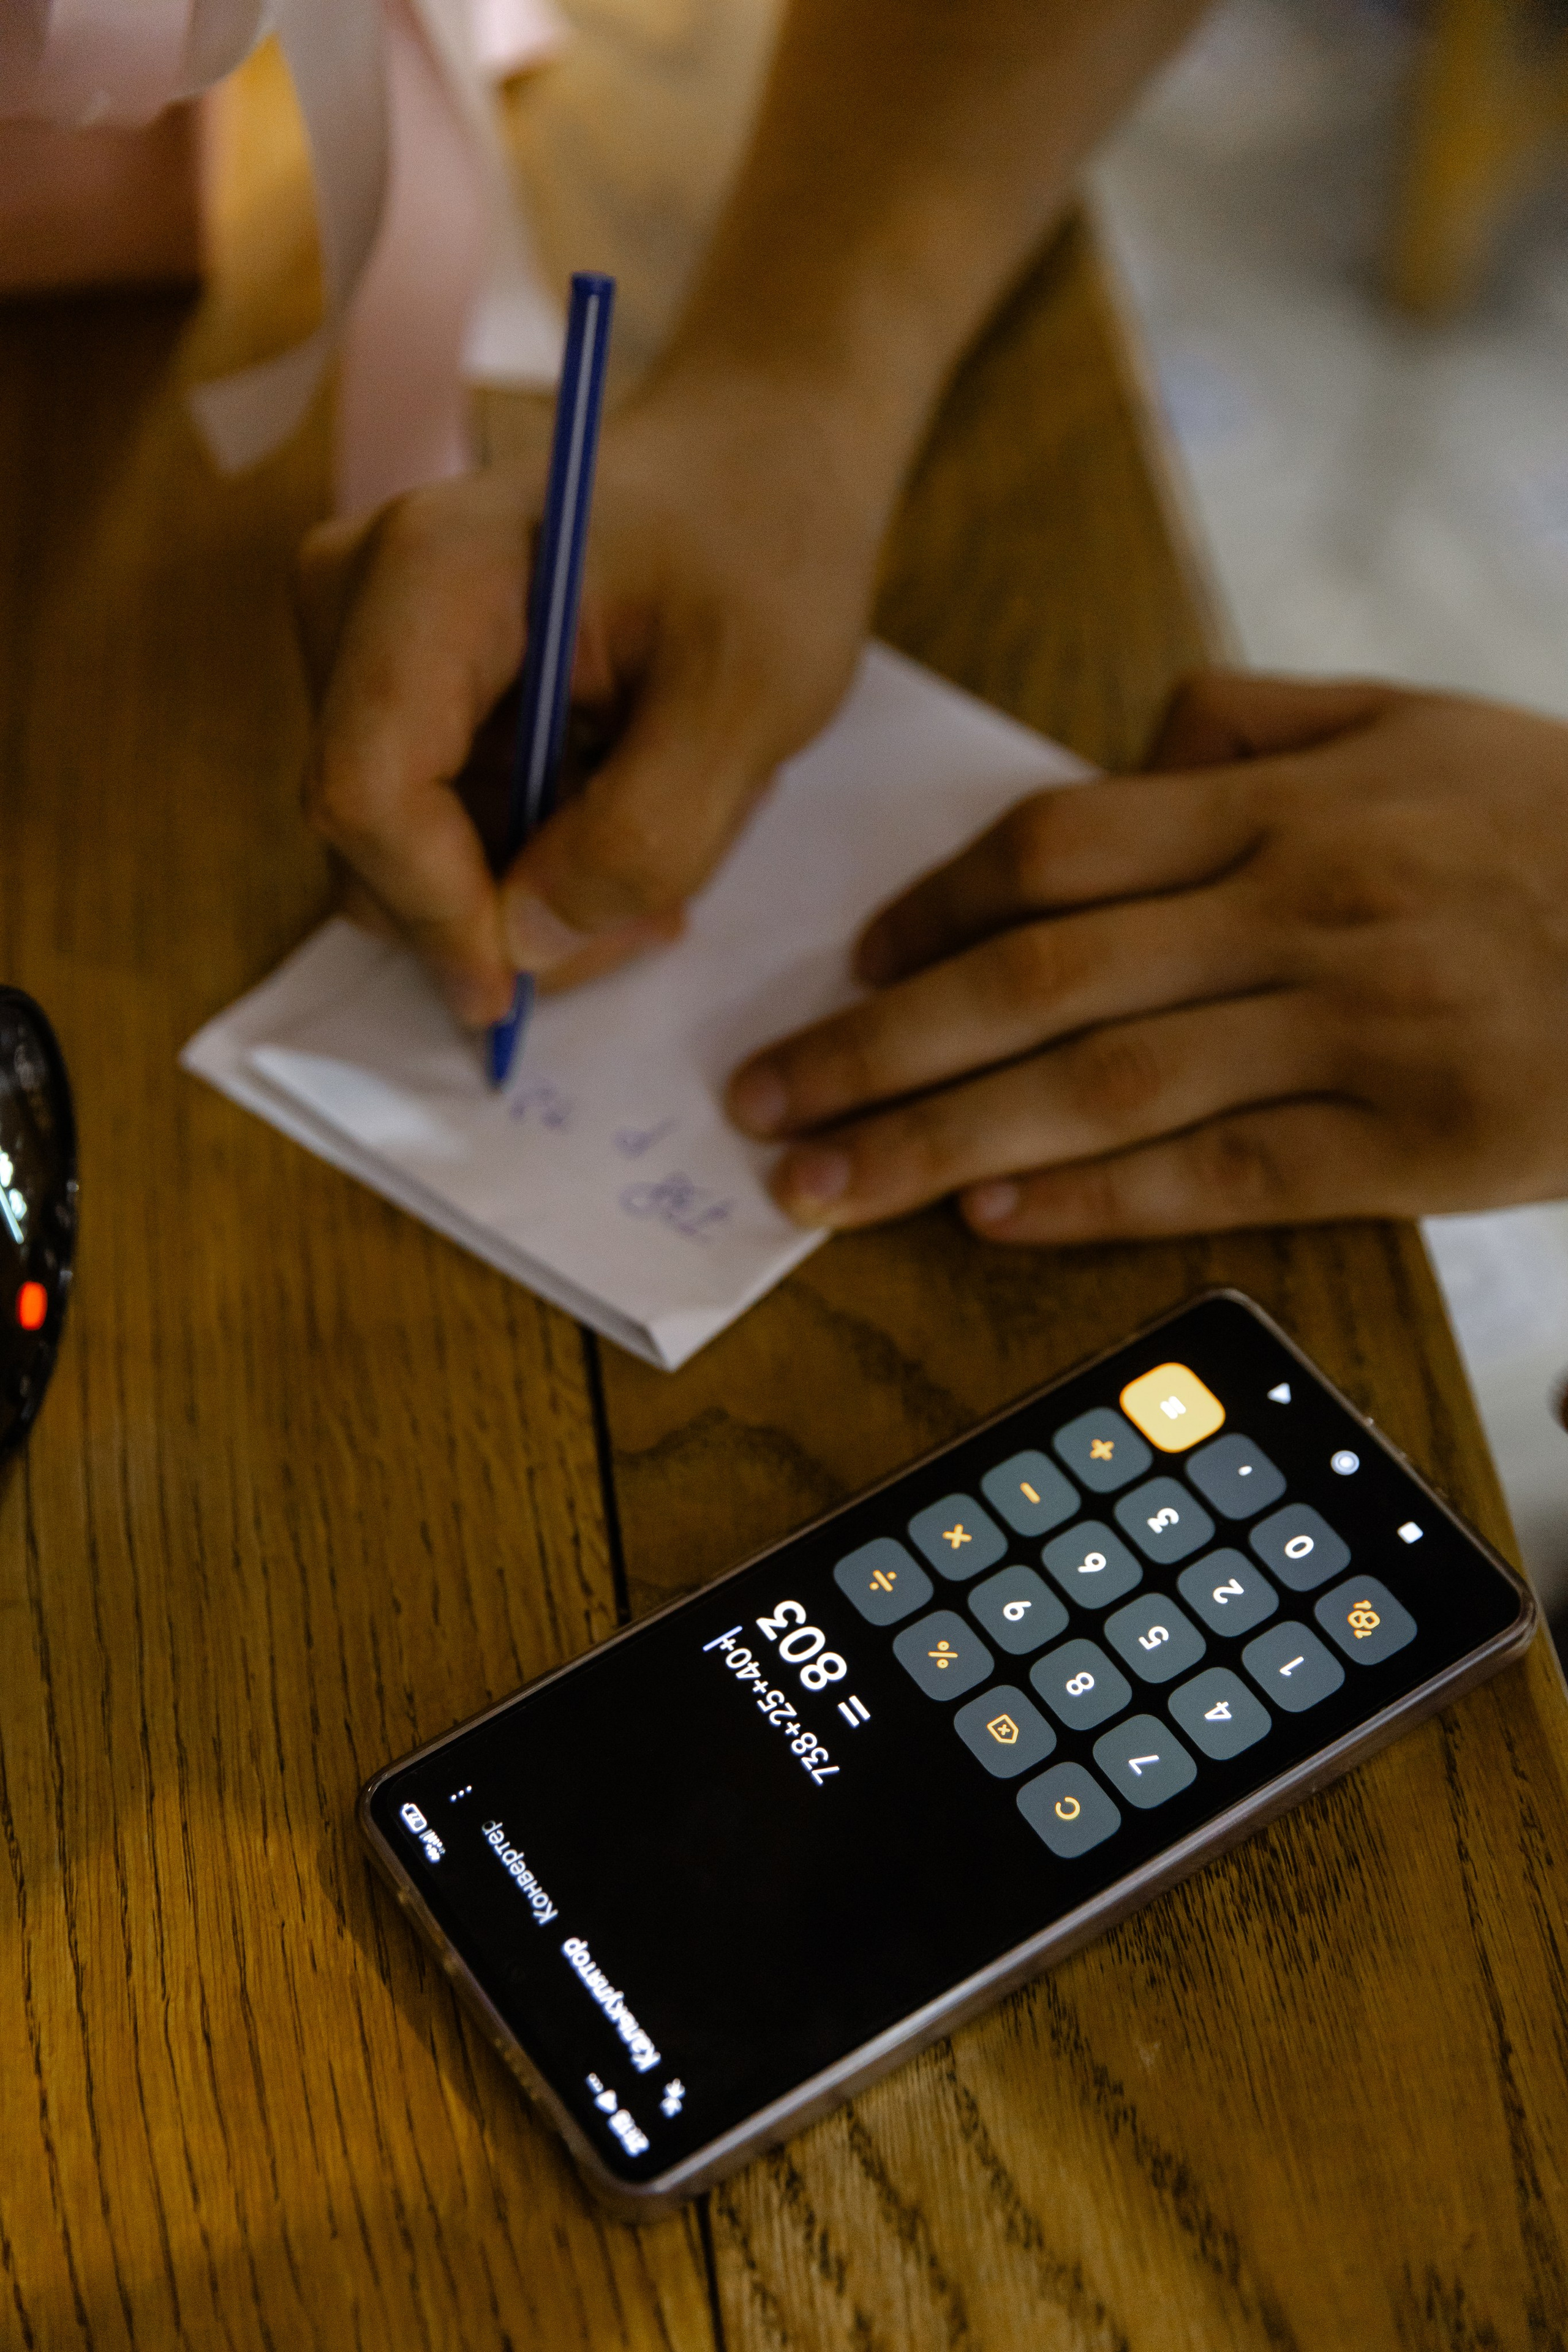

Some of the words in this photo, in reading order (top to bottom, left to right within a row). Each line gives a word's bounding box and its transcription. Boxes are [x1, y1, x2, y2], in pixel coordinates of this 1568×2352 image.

[1147, 1507, 1180, 1534] 3
[1284, 1535, 1314, 1559] 0
[1077, 1552, 1107, 1574] 6
[1212, 1578, 1245, 1605] 2
[1003, 1600, 1032, 1622] 9
[755, 1600, 848, 1692] 803
[1138, 1626, 1170, 1651] 5
[1279, 1656, 1305, 1677] 1
[1065, 1672, 1095, 1697] 8
[1204, 1701, 1233, 1722] 4
[1128, 1754, 1160, 1776] 7
[1055, 1796, 1080, 1820] C
[481, 1819, 559, 1926] Конвертер
[562, 1937, 661, 2073] Калькулятор
